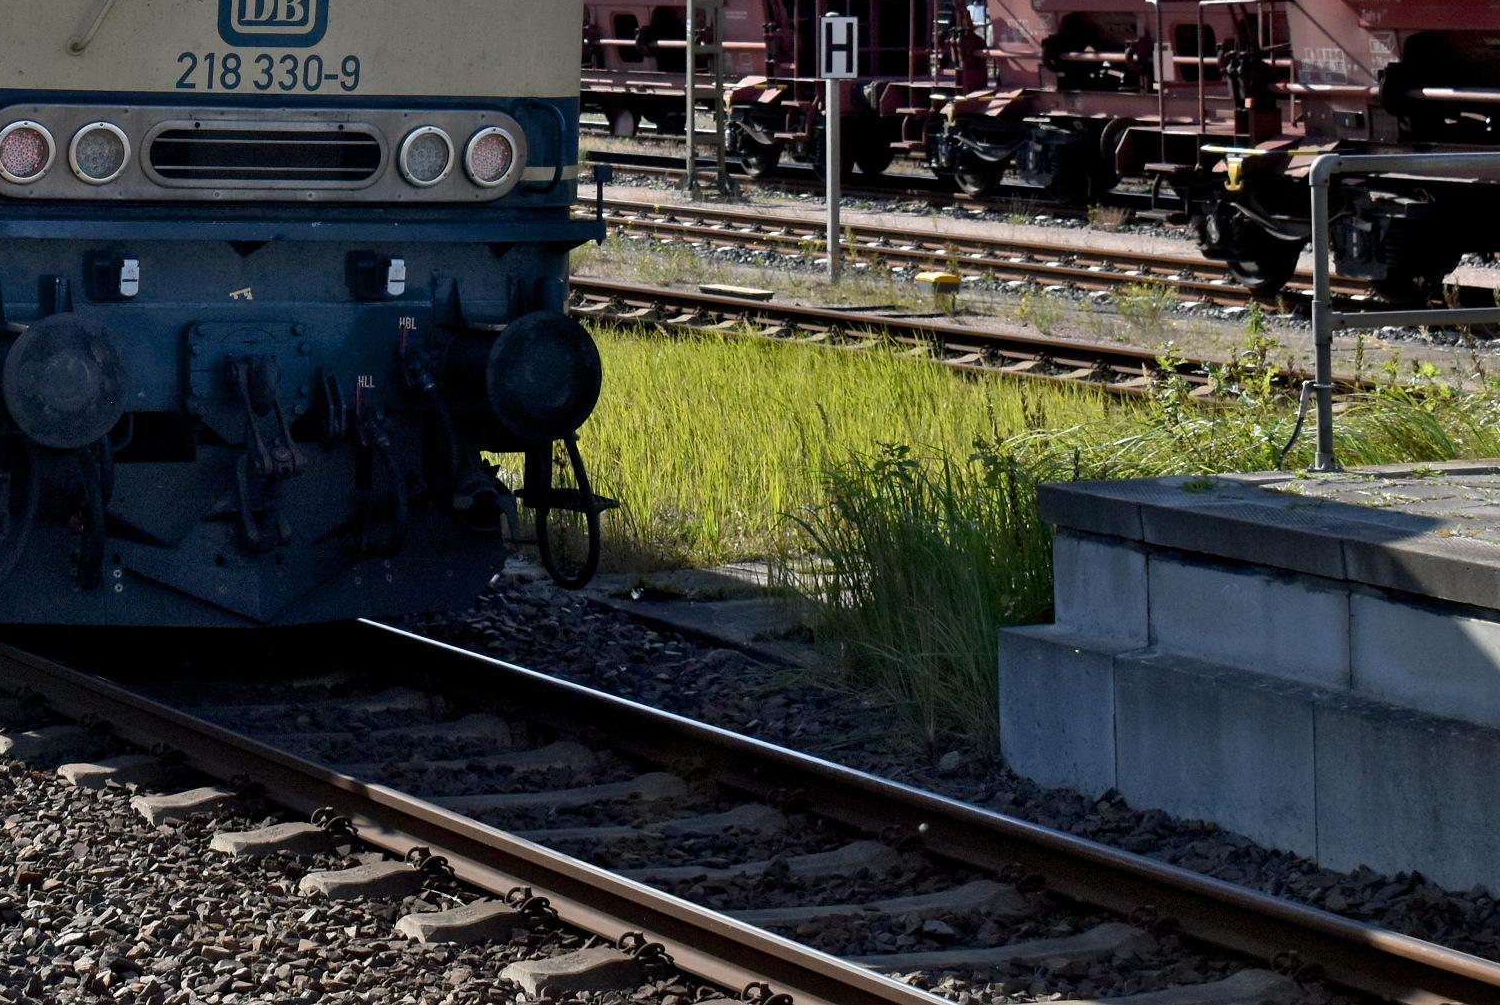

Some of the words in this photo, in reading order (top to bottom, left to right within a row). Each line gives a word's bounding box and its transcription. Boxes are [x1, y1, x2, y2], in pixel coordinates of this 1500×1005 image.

[825, 22, 854, 74] H
[175, 52, 242, 90] 218
[252, 53, 361, 92] 330-9
[399, 316, 417, 330] HBL
[358, 375, 375, 388] HLL
